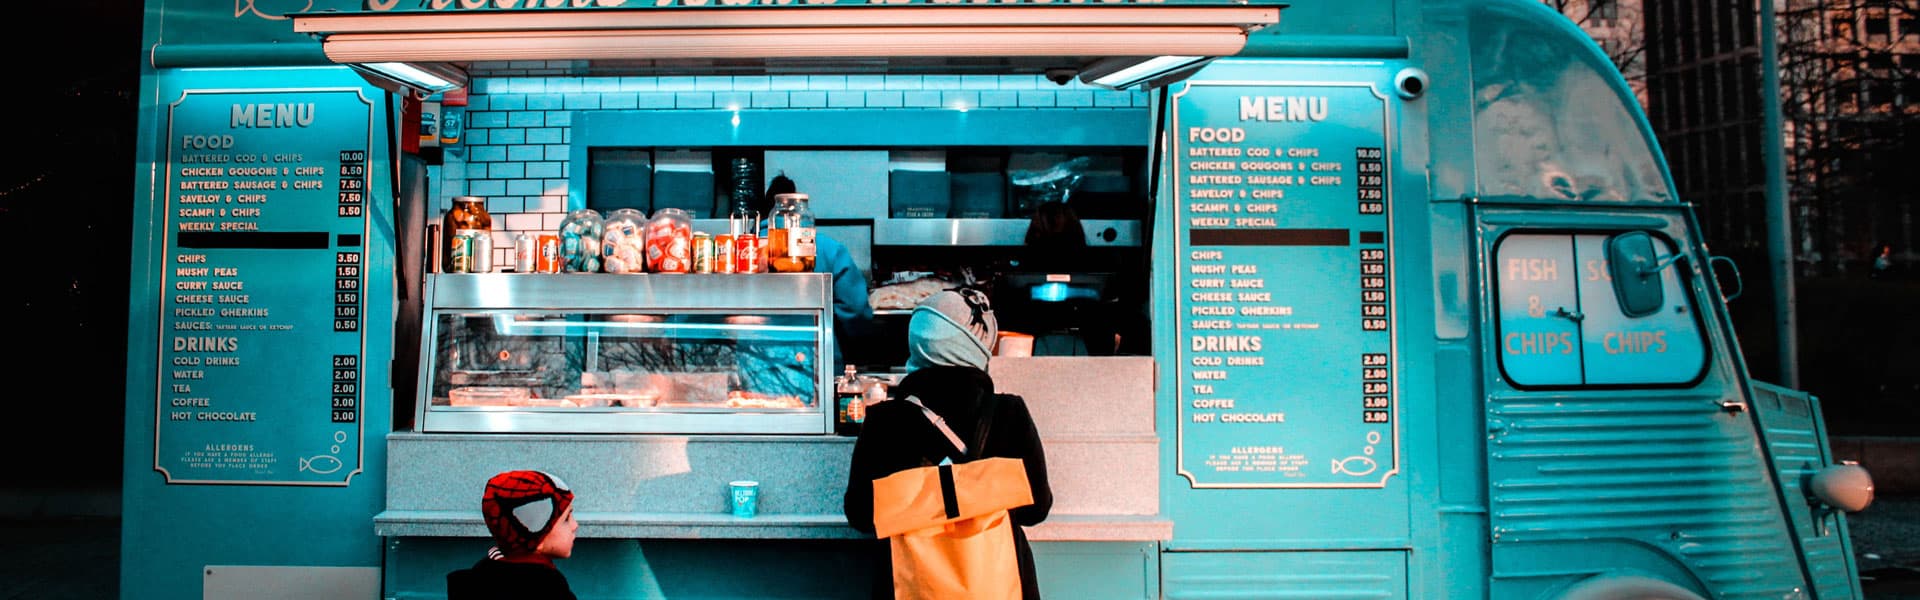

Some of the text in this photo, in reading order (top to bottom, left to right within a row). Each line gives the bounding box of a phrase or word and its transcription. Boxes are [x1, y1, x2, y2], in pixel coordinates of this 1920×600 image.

[1240, 94, 1328, 121] MENU
[232, 102, 315, 127] MENU
[1189, 127, 1245, 143] FOOD
[183, 134, 234, 149] FOOD
[1189, 147, 1242, 157] BATTERED
[1246, 147, 1271, 157] COD
[1287, 147, 1319, 157] CHIPS
[182, 154, 230, 163] BATTERED
[235, 154, 257, 162] COD
[274, 153, 303, 162] CHIPS
[341, 152, 363, 161] 10.00
[181, 167, 224, 176] CHICKEN
[295, 166, 324, 175] CHIPS
[341, 166, 362, 175] 8.50
[1190, 161, 1236, 171] CHICKEN
[1311, 162, 1342, 171] CHIPS
[180, 181, 229, 190] BATTERED
[234, 180, 276, 189] SAUSAGE
[294, 180, 323, 189] CHIPS
[340, 180, 361, 189] 7.50
[1190, 175, 1243, 184] BATTERED
[1247, 175, 1293, 185] SAUSAGE
[1310, 175, 1342, 185] CHIPS
[1359, 175, 1381, 185] 7.50
[180, 194, 220, 203] SAVELOY
[237, 194, 267, 203] CHIPS
[340, 193, 361, 202] 7.50
[1190, 188, 1234, 199] SAVELOY
[1251, 189, 1284, 199] CHIPS
[1359, 189, 1381, 199] 7.50
[179, 208, 215, 217] SCAMPI
[231, 208, 261, 217] CHIPS
[339, 206, 360, 216] 8.50
[1190, 203, 1230, 213] SCAMPI
[1246, 203, 1278, 213] CHIPS
[179, 222, 259, 231] WEEKLY SPECIAL
[1190, 217, 1277, 227] WEEKLY SPECIAL
[177, 253, 359, 263] CHIPS 3.50
[1191, 250, 1384, 260] CHIPS 3.50
[176, 267, 357, 276] MUSHY PEAS 1.50
[1191, 264, 1384, 274] MUSHY PEAS 1.50
[1508, 258, 1557, 281] FISH
[176, 280, 357, 290] CURRY SAUCE 1.50
[1191, 278, 1384, 288] CURRY SAUCE 1.50
[176, 293, 356, 303] CHEESE SAUCE 1.50
[1191, 291, 1385, 302] CHEESE SAUCE 1.50
[1191, 305, 1236, 316] PICKLED
[1528, 295, 1545, 318] &
[175, 307, 356, 317] PICKLED GHERKINS 1.00
[335, 320, 356, 329] 0.50
[174, 336, 238, 351] DRINKS
[1192, 335, 1262, 352] DRINKS
[1504, 332, 1573, 355] CHIPS
[1603, 331, 1667, 355] CHIPS
[174, 356, 355, 366] COLD DRINKS 2.00
[1192, 356, 1223, 366] COLD
[1227, 356, 1265, 366] DRINKS
[173, 370, 356, 380] WATER 2.00
[1193, 370, 1227, 380] WATER
[173, 384, 355, 393] TEA 2.00
[1193, 384, 1214, 394] TEA
[172, 397, 354, 407] COFFEE 3.00
[1193, 398, 1235, 409] COFFEE
[171, 411, 354, 421] HOT CHOCOLATE 3.00
[1193, 412, 1216, 423] HOT
[1221, 412, 1285, 423] CHOCOLATE
